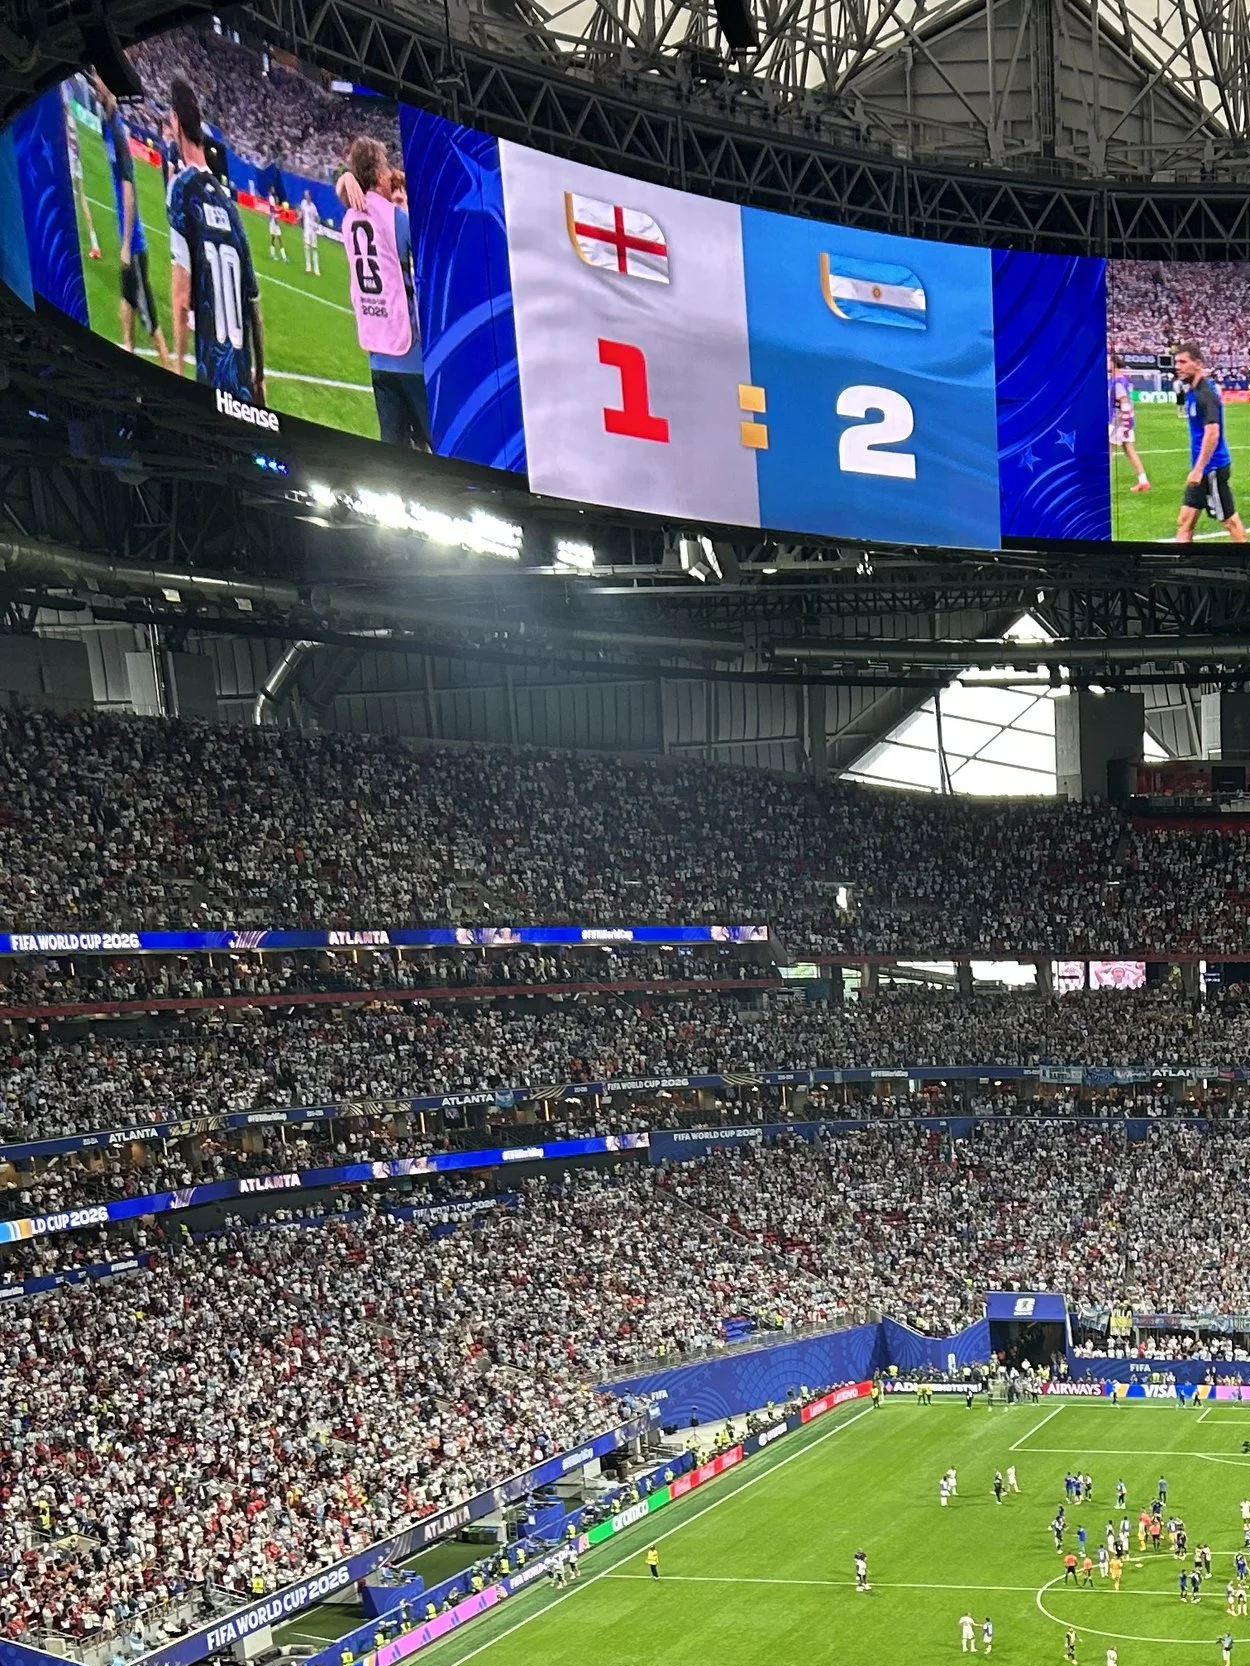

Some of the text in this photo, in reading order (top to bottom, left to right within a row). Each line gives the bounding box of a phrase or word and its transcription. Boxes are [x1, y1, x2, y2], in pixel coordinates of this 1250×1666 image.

[361, 304, 389, 319] 2026
[215, 389, 280, 432] Hisense
[597, 337, 670, 444] 1
[836, 385, 917, 480] 2
[10, 933, 140, 951] FIFA WORLD CUP 2026
[328, 930, 390, 945] ATLANTA
[607, 1078, 689, 1091] FIFA WORLD CUP 2026
[441, 1093, 495, 1107] ATLANTA
[108, 1127, 159, 1144] ATLANTA
[673, 1132, 690, 1142] FIFA
[690, 1130, 718, 1140] WORLD
[720, 1129, 737, 1138] CUP
[239, 1173, 301, 1193] ATLANTA
[47, 1213, 69, 1231] CUP
[69, 1206, 109, 1229] 2026
[1129, 1363, 1151, 1372] FIFA
[650, 1389, 669, 1401] FIFA
[1046, 1383, 1101, 1395] AIRWAYS
[1143, 1384, 1178, 1398] VISA
[423, 1505, 470, 1541] ATLANTA
[612, 1500, 649, 1531] aramco
[206, 1565, 350, 1651] FIFA WORLD CUP 2026
